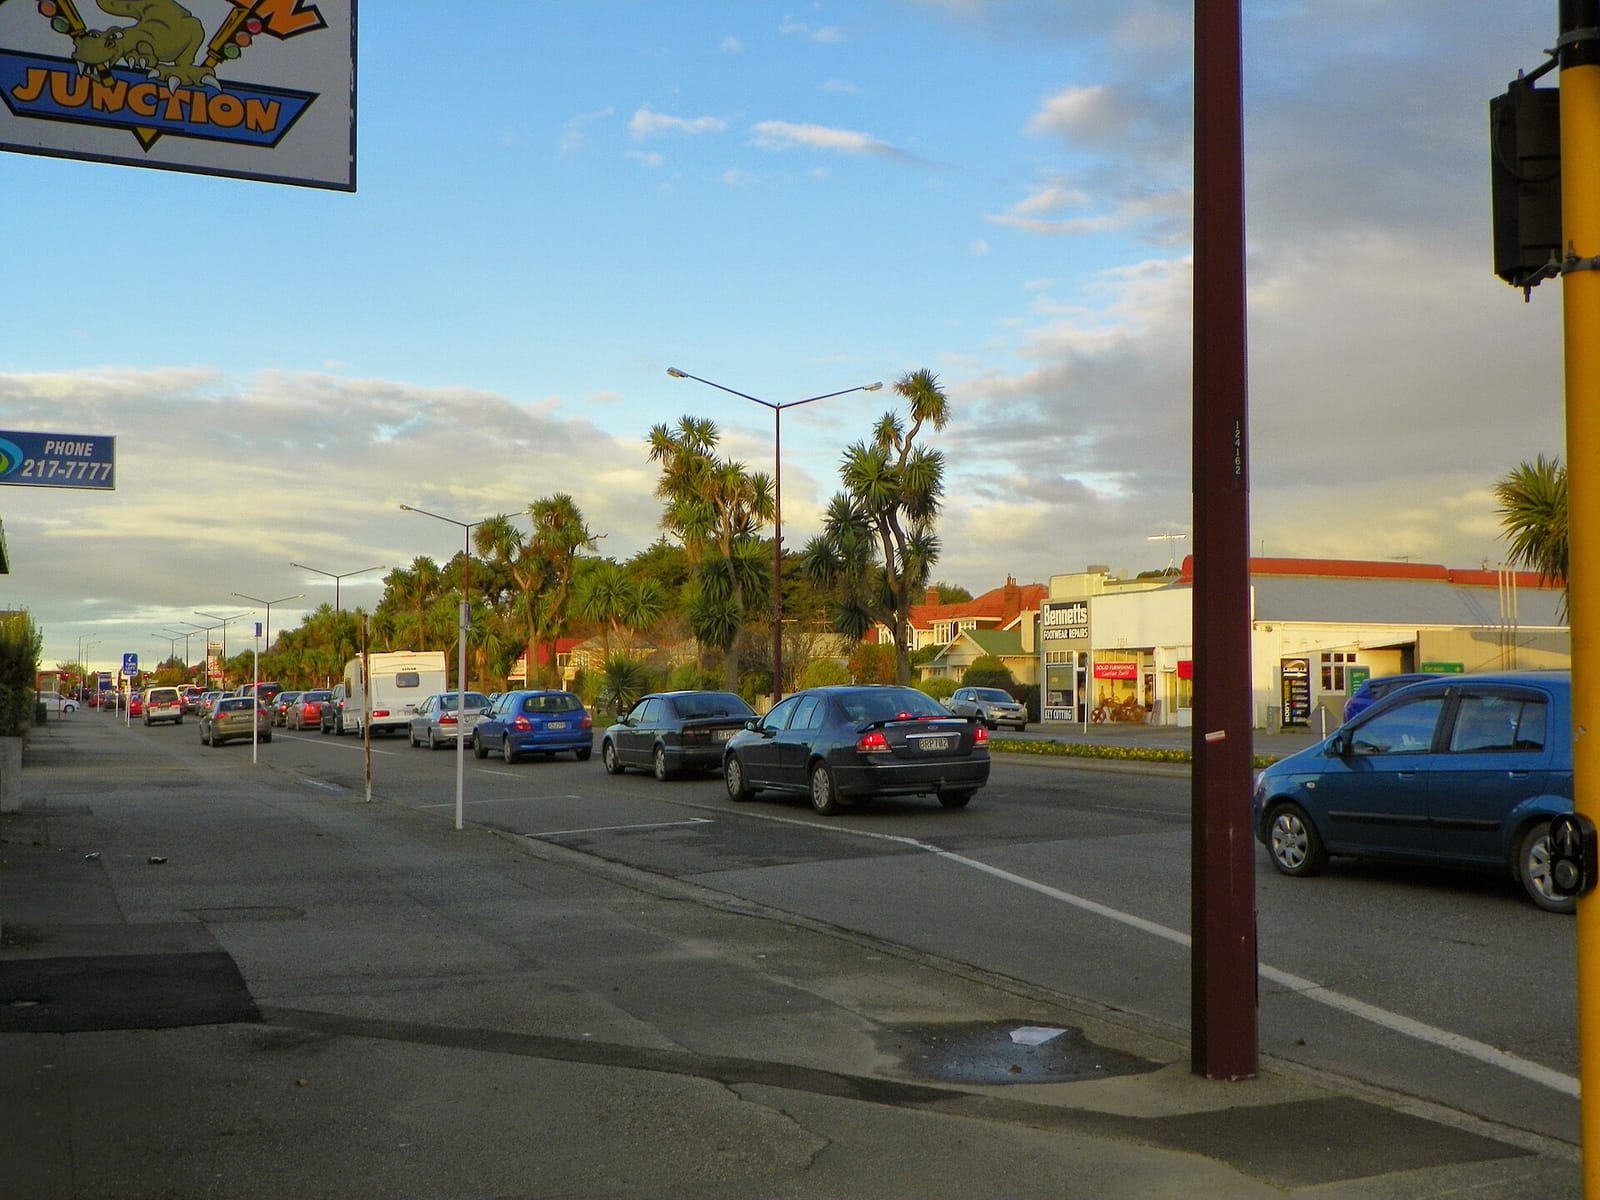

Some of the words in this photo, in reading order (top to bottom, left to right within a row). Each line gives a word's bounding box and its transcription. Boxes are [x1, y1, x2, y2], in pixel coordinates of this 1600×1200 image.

[11, 68, 282, 133] JUNCTION
[44, 440, 94, 457] PHONE
[21, 459, 113, 481] 217-7777
[1043, 603, 1088, 626] Bennetts
[1043, 629, 1068, 640] FOOTWEAR
[1069, 627, 1089, 639] REPAIRS
[1053, 709, 1072, 721] CUTTING
